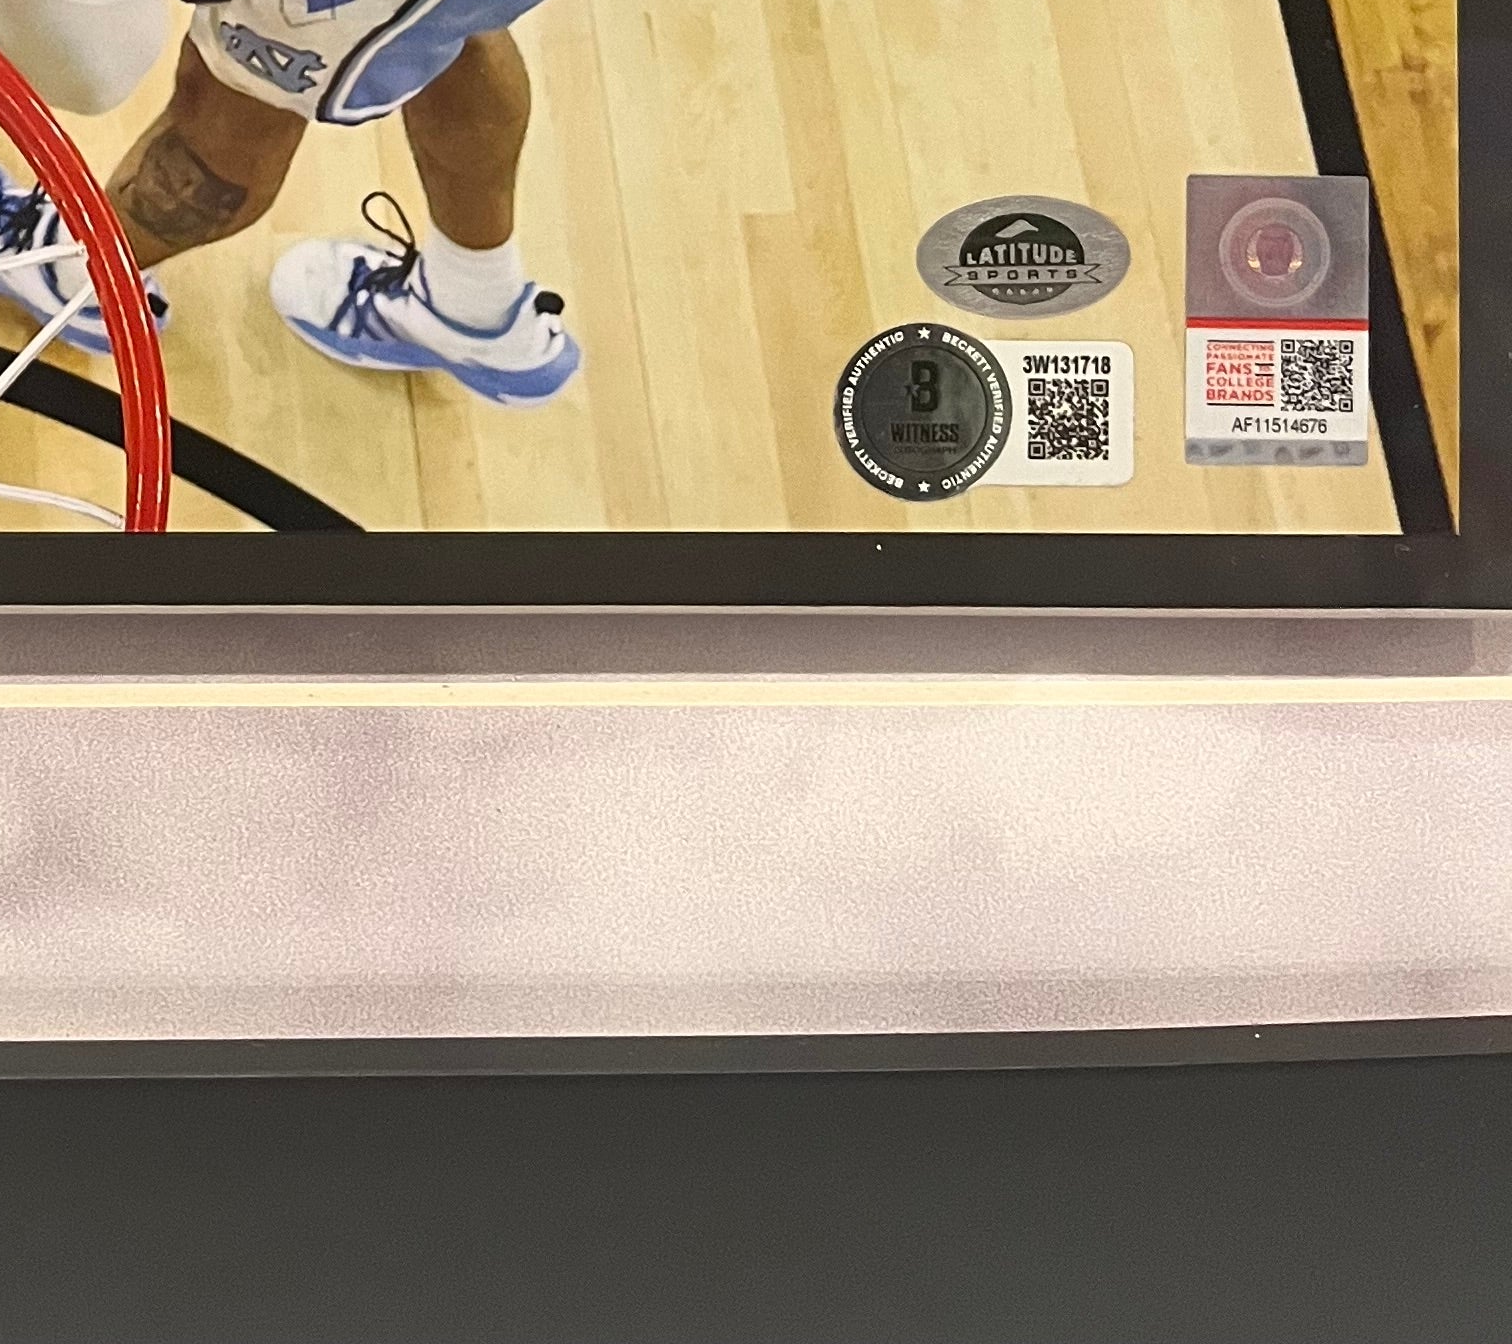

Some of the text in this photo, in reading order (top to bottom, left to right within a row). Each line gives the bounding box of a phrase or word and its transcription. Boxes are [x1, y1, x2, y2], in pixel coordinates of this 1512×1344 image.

[966, 242, 1077, 265] LATITUDE
[967, 268, 1078, 281] SPORTS
[1022, 355, 1112, 375] 3W131718
[1206, 362, 1253, 375] FANS
[1206, 376, 1274, 388] COLLEGE
[1206, 388, 1275, 402] BRANDS
[841, 330, 905, 490] BECKETT VERIFIED AUTHENTIC
[940, 331, 1005, 491] BECKETT VERIFIED AUTHENTIC
[890, 422, 959, 444] WITNESS
[1231, 416, 1328, 434] AF11514676
